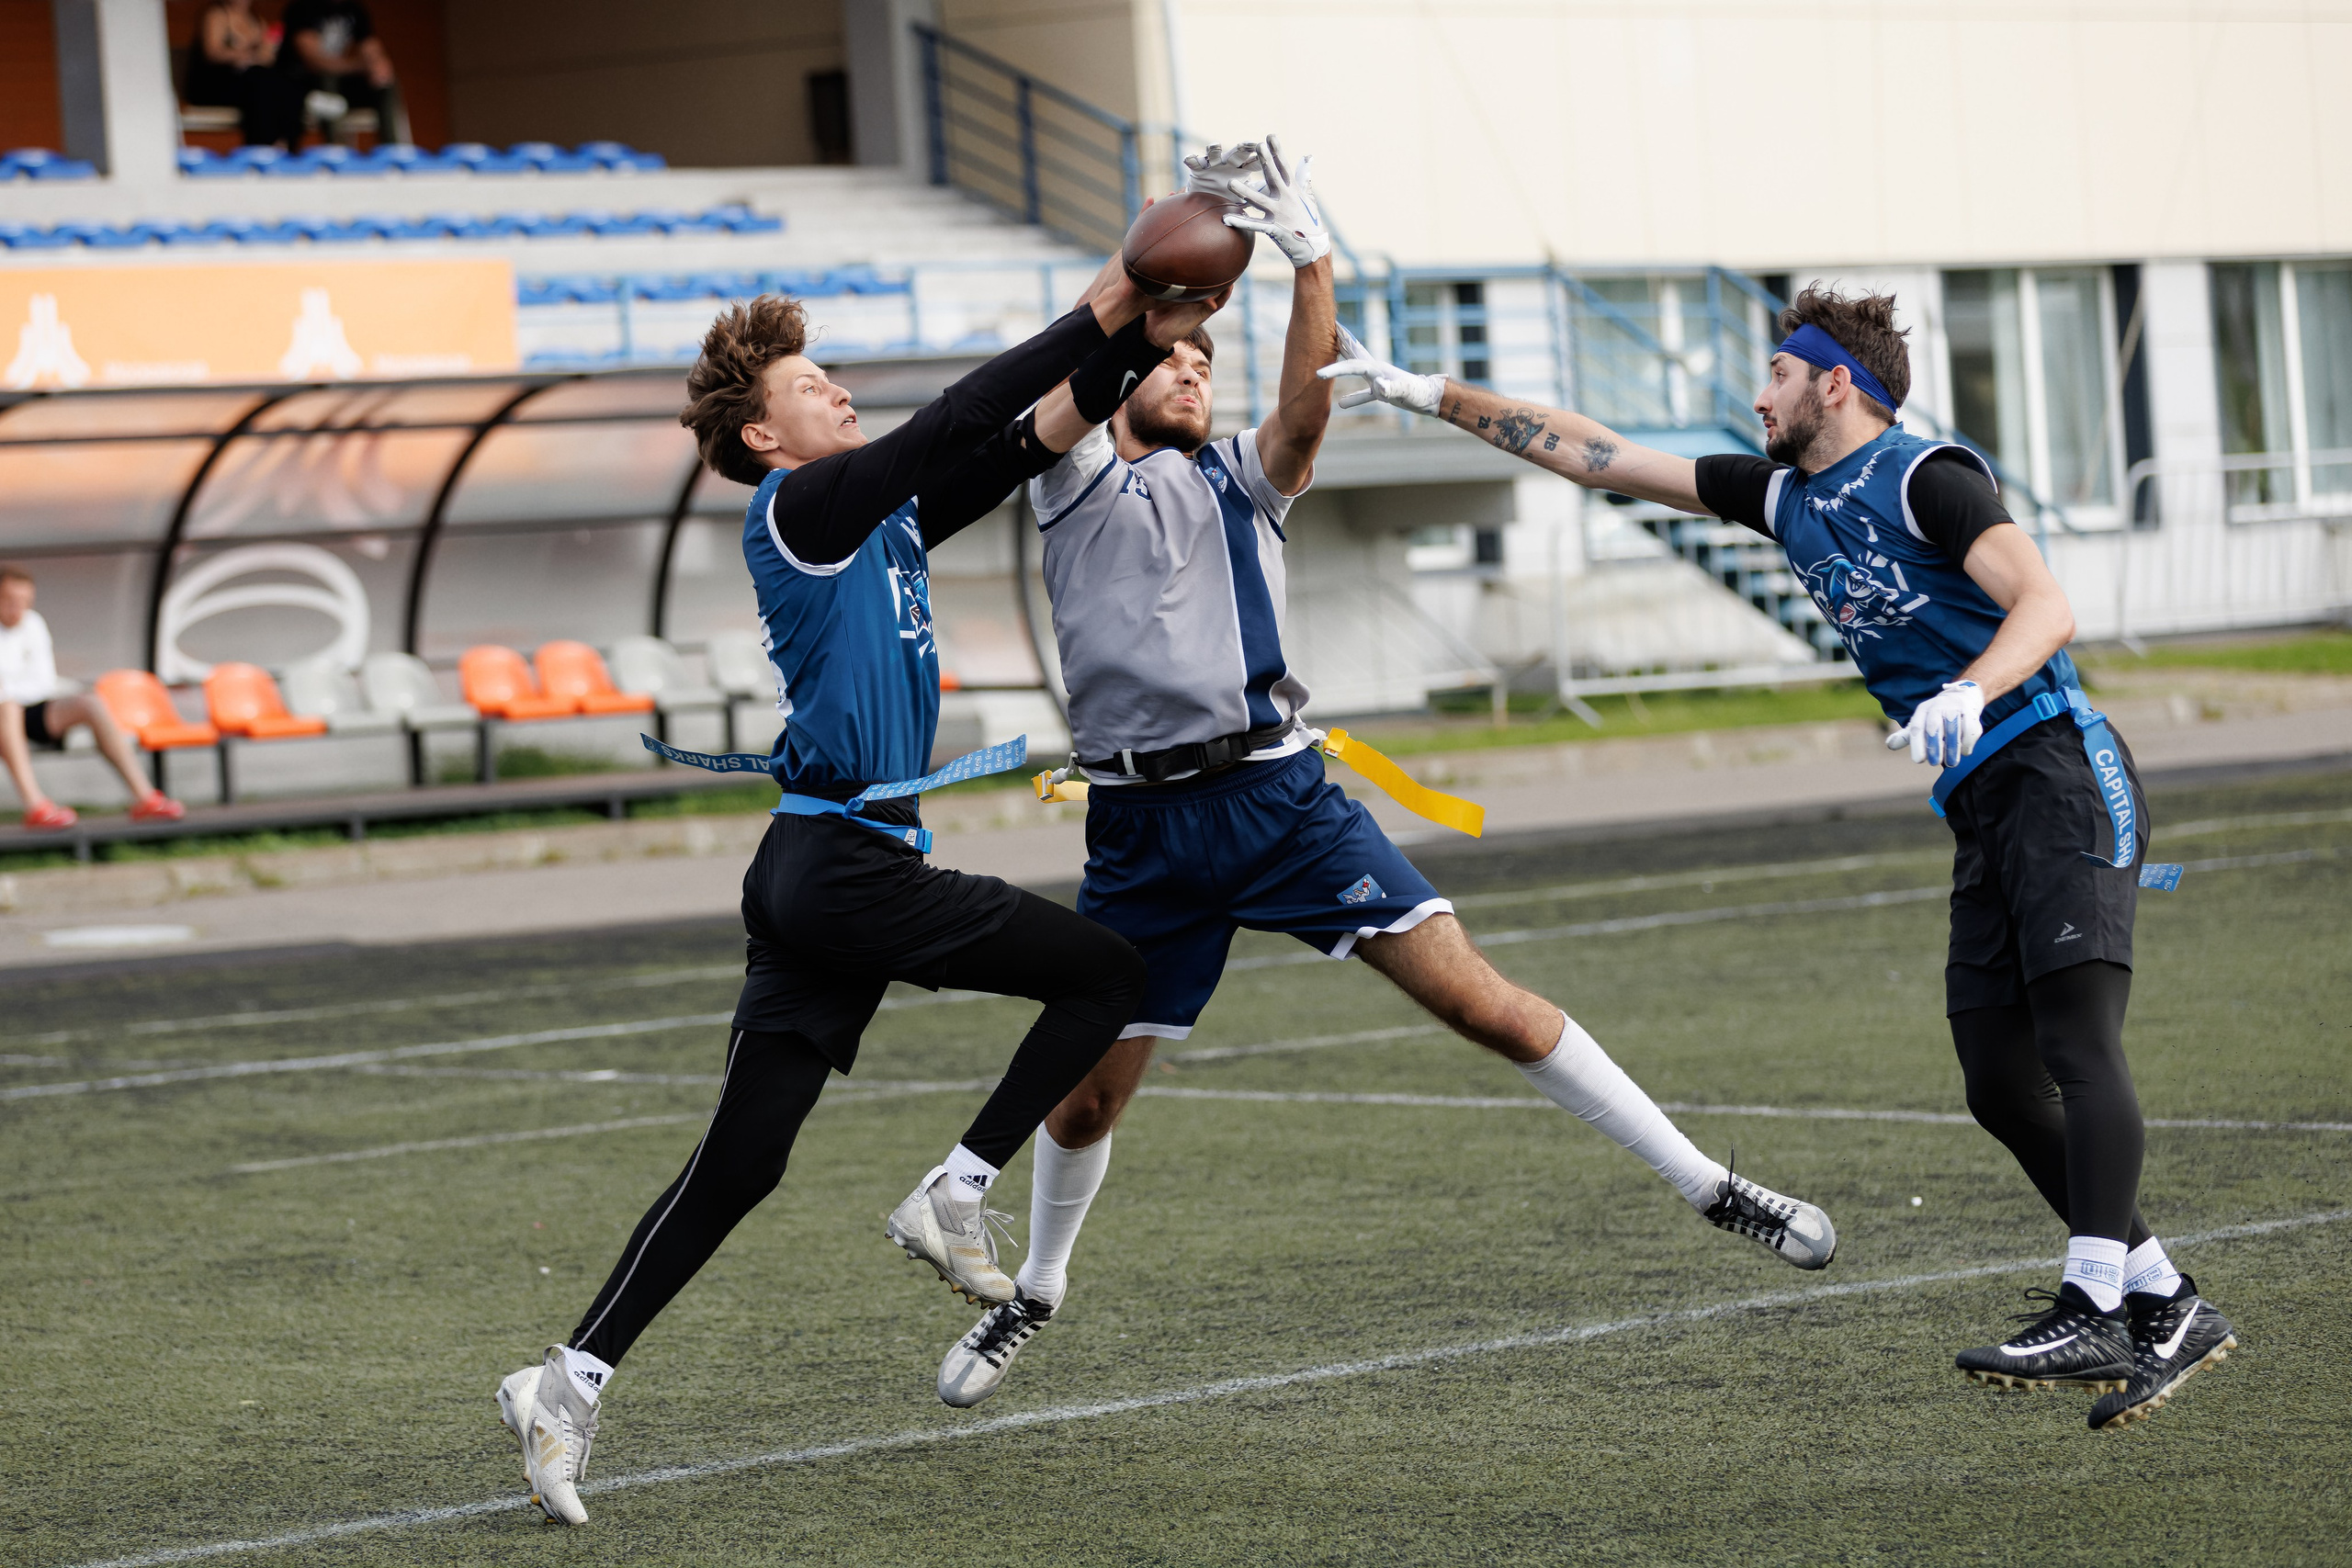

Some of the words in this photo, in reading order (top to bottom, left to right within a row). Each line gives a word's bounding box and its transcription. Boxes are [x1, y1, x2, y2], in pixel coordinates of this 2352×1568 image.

[1477, 415, 1491, 429] 28
[1544, 432, 1560, 451] RB
[662, 745, 742, 770] SHARKS
[745, 756, 771, 771] AL
[2095, 749, 2132, 835] CAPITAL
[959, 1176, 987, 1192] adidas
[573, 1371, 602, 1393] adidas
